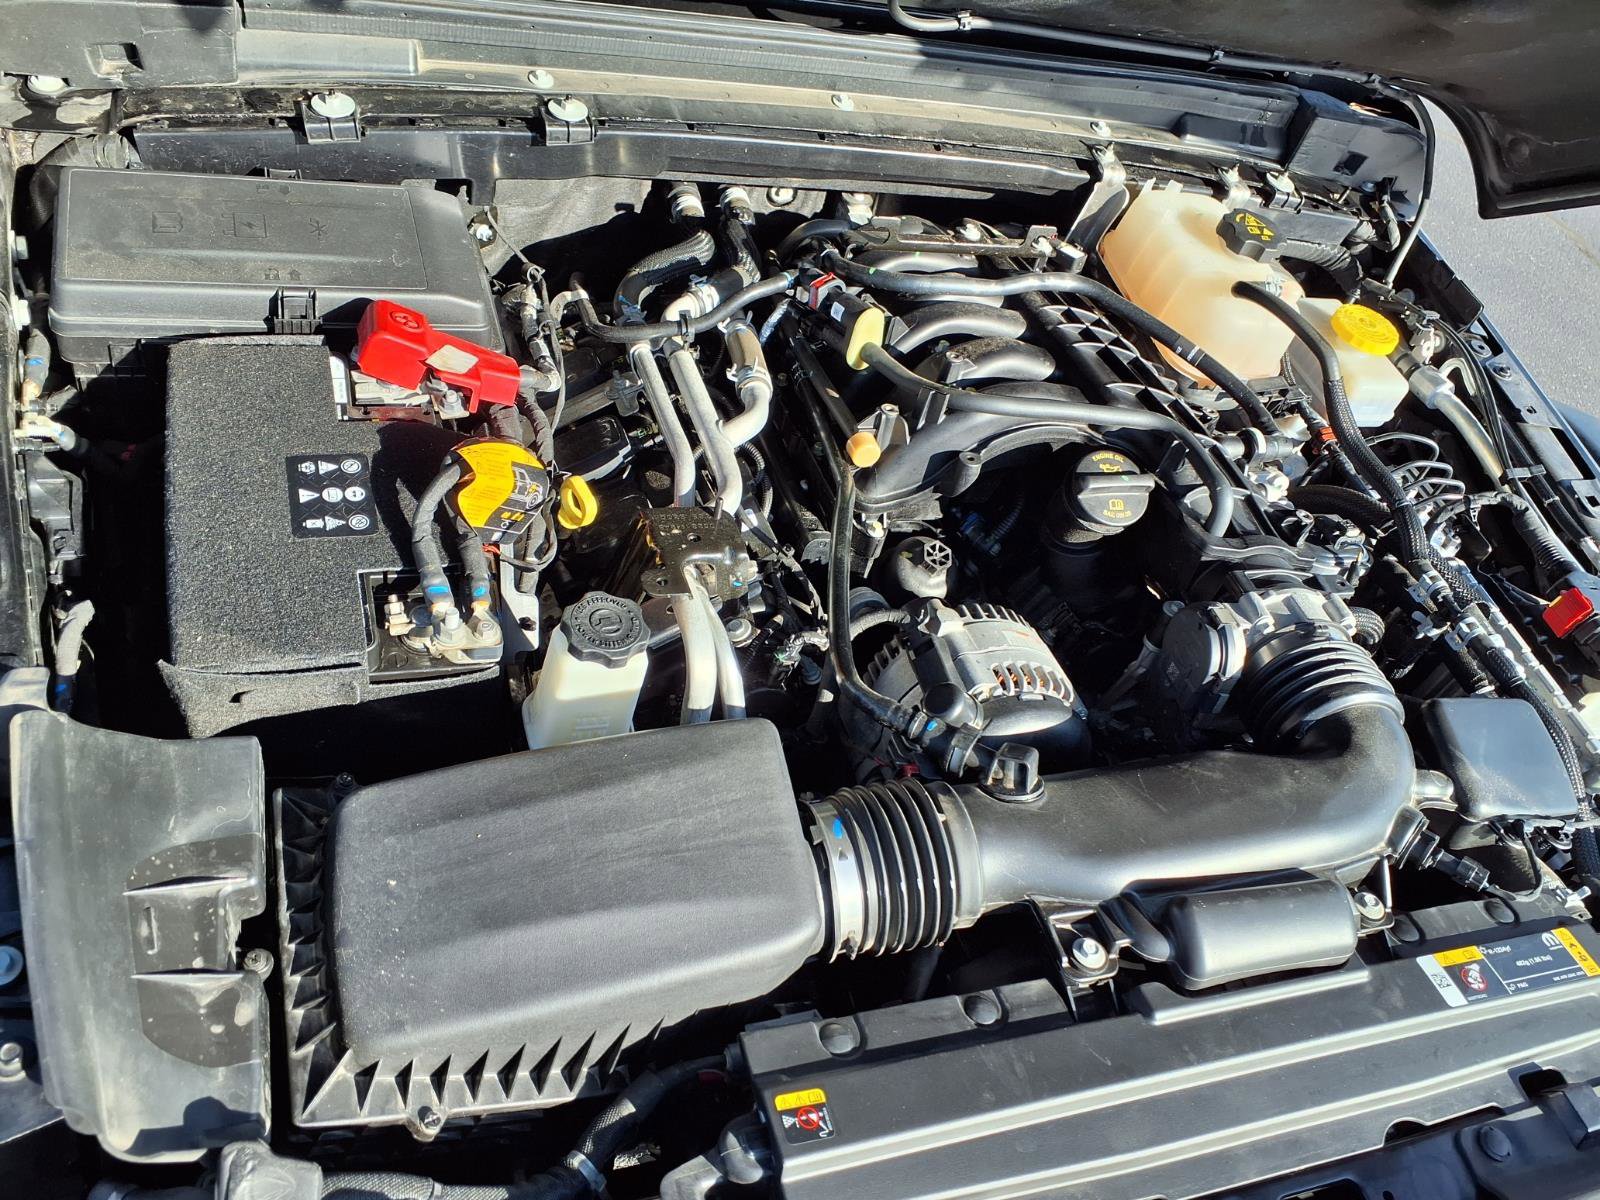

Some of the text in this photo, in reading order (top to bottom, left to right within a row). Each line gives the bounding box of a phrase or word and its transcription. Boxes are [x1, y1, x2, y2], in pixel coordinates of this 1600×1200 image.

[1092, 453, 1124, 463] ENGINE OIL
[587, 596, 627, 609] APPROVED
